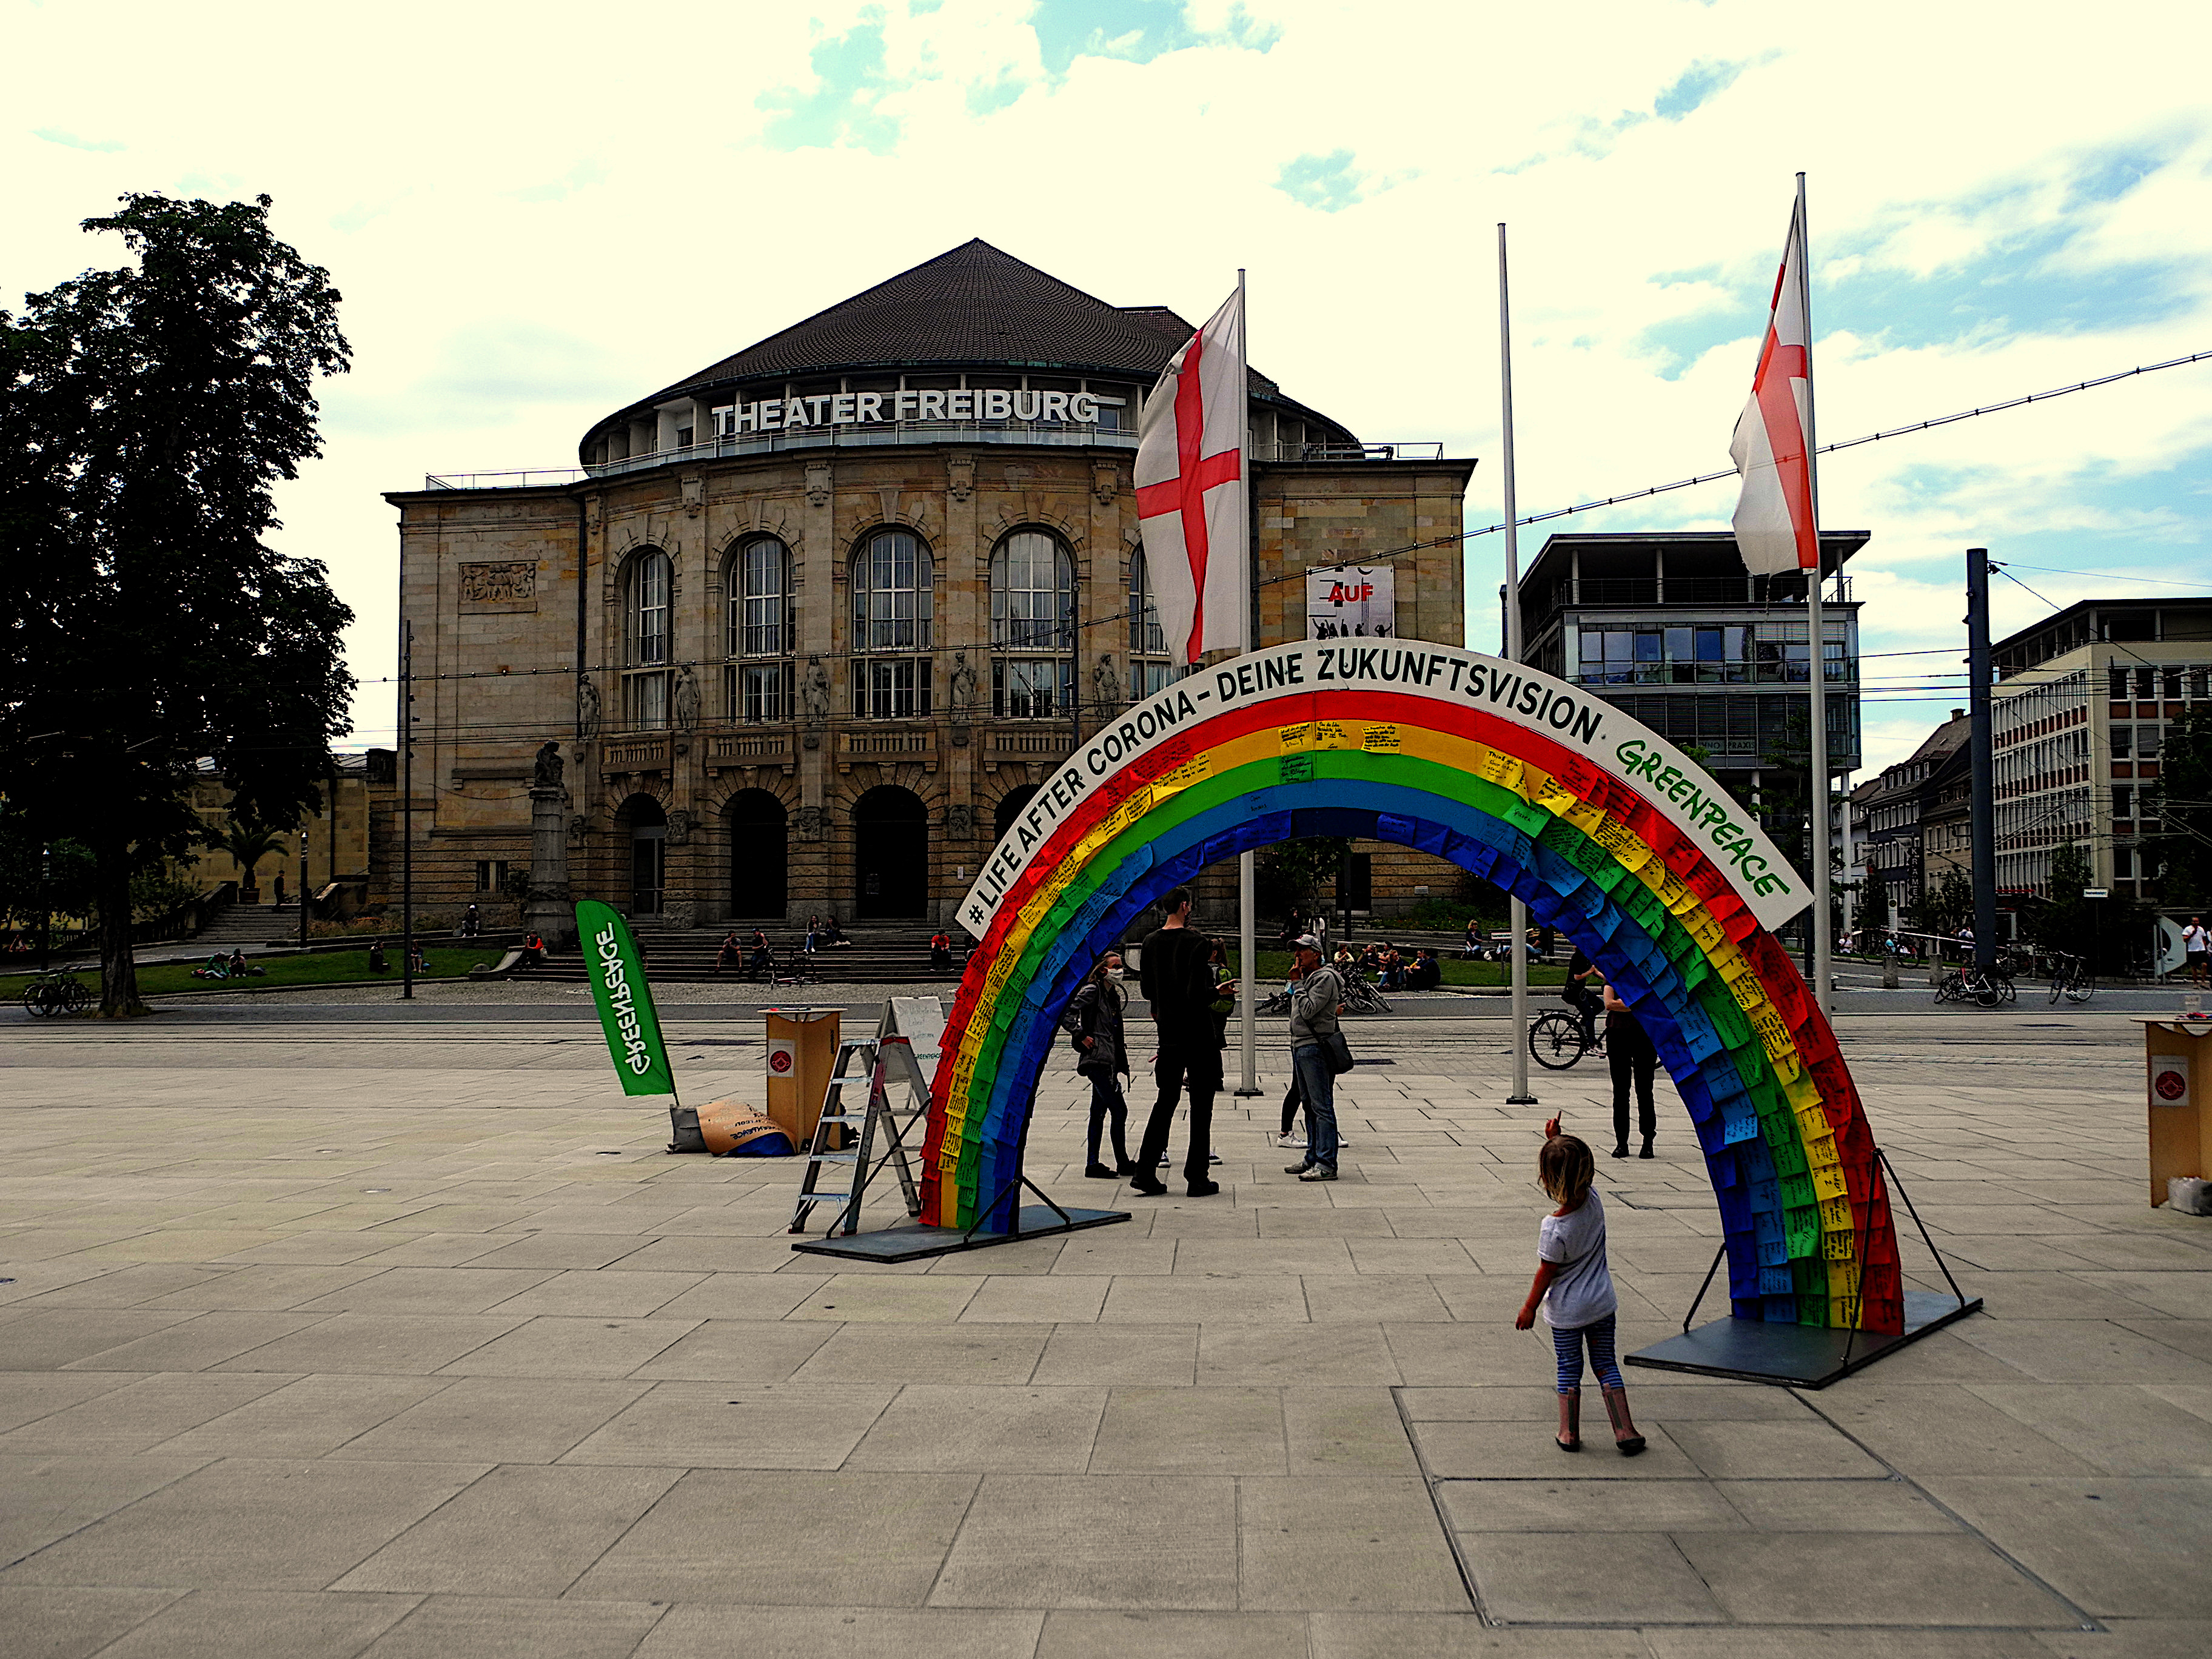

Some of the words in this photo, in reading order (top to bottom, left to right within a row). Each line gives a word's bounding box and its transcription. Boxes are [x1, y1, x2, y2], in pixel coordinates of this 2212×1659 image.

[712, 392, 883, 437] THEATER
[894, 389, 1101, 424] FREIBURG
[1327, 585, 1374, 602] AUF
[1017, 768, 1087, 854] AFTER
[1216, 652, 1304, 703] DEINE
[1317, 648, 1603, 745] ZUKUNFTSVISION
[1728, 741, 1755, 749] PRAXIS
[1616, 740, 1791, 897] GREENPEACE
